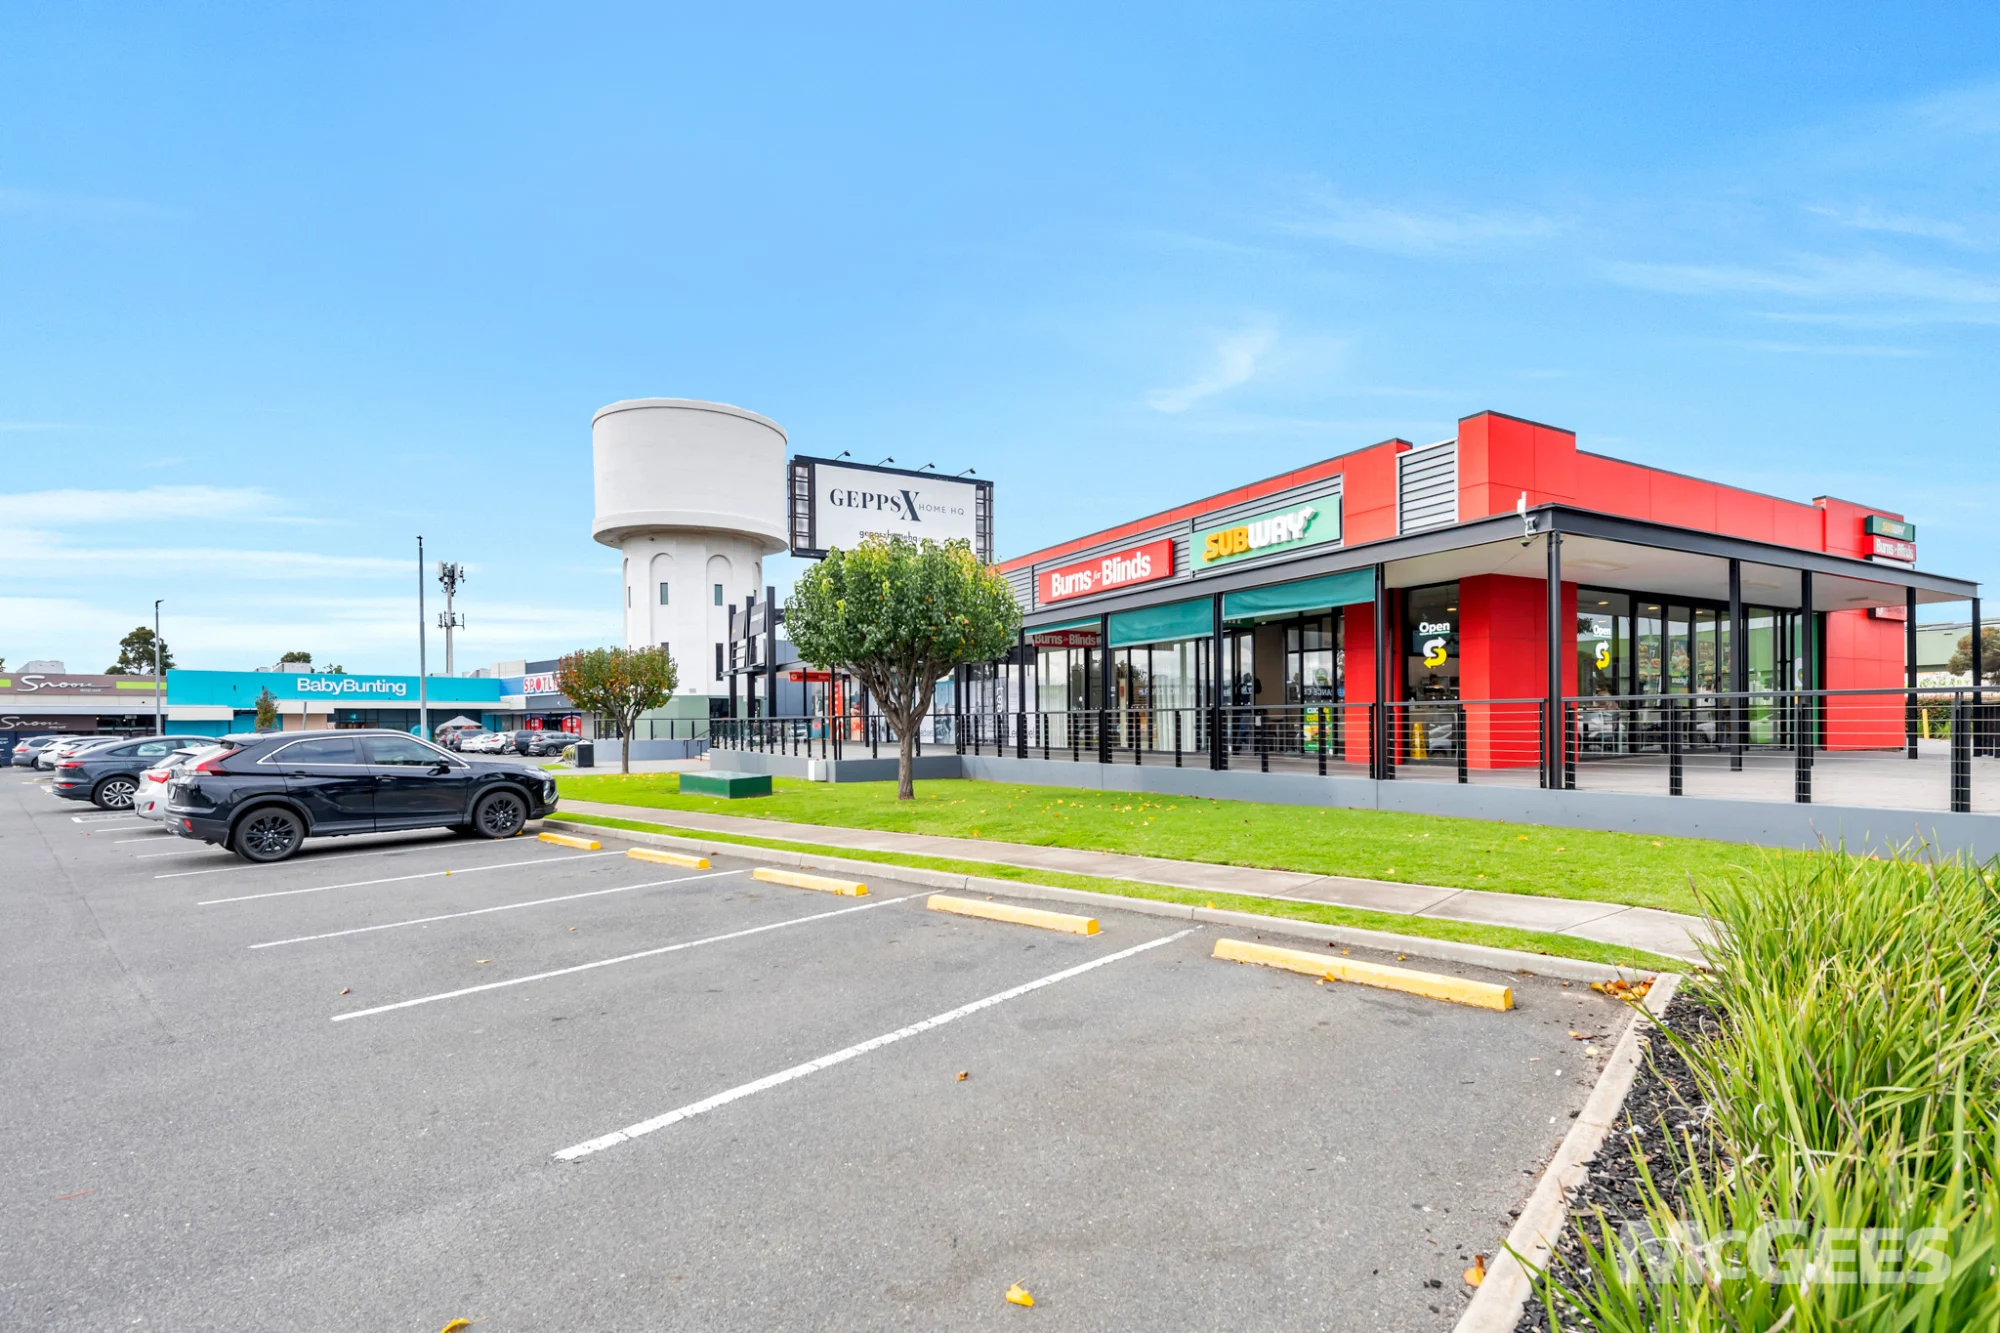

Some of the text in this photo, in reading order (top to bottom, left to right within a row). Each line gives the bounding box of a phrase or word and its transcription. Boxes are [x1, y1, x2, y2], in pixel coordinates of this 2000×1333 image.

[919, 503, 946, 514] HOME
[951, 507, 965, 516] HQ
[1203, 506, 1317, 562] SUBWAY
[1876, 538, 1894, 556] Burns
[1051, 551, 1151, 598] Burns for Blinds
[1419, 622, 1450, 634] Open
[1593, 624, 1611, 636] Open
[1034, 634, 1063, 645] Burns
[1069, 633, 1096, 646] Blinds
[523, 676, 559, 693] SPOTL
